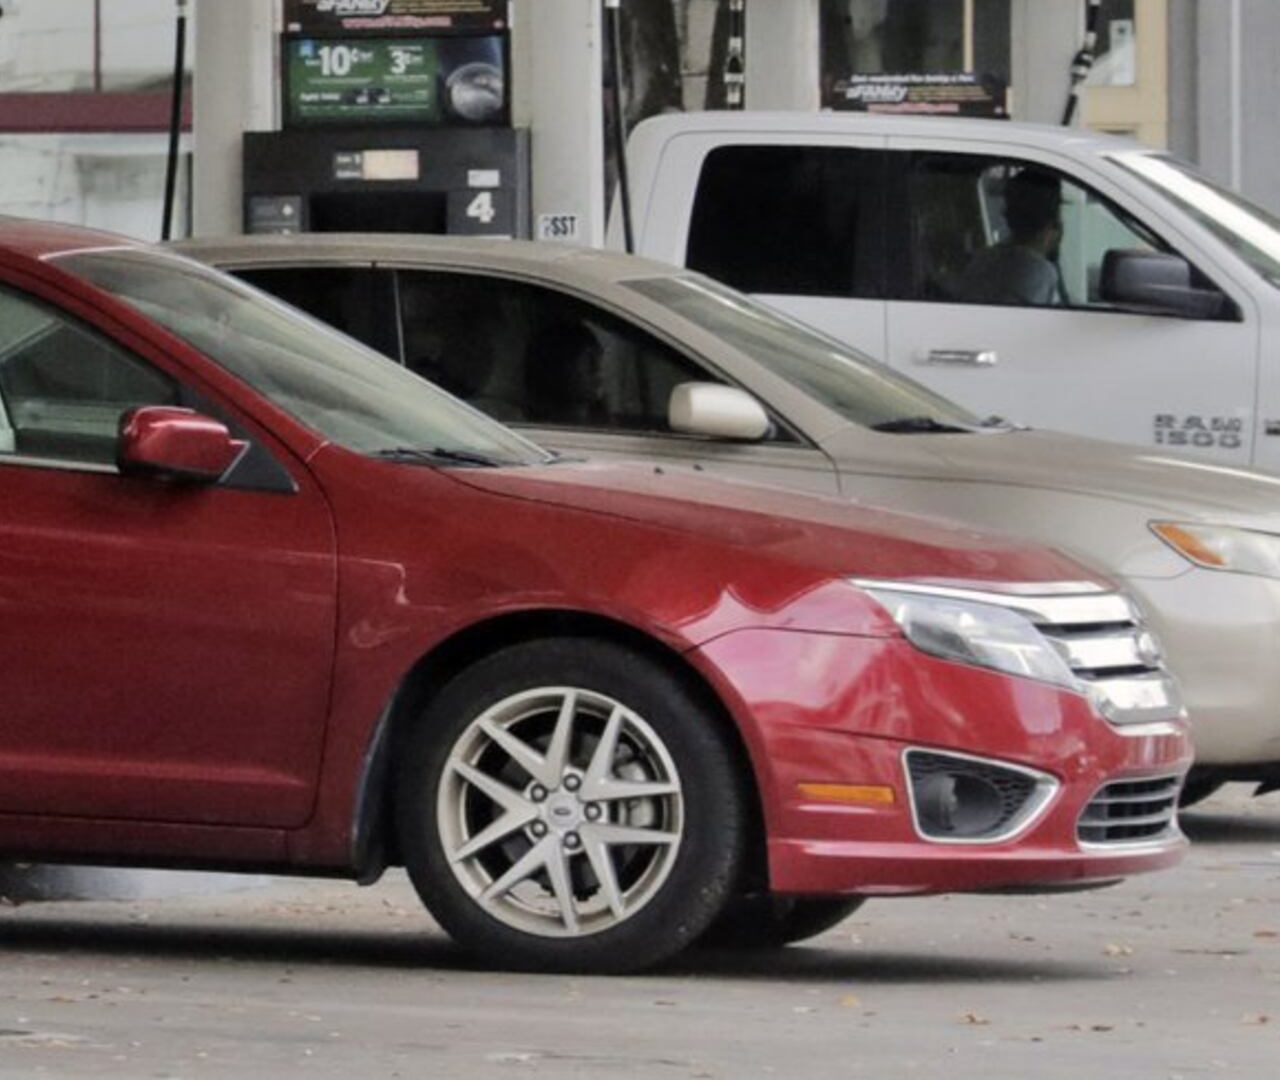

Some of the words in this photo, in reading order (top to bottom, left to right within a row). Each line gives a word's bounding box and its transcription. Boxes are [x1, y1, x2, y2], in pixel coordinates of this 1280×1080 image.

[466, 191, 496, 223] 4
[1154, 414, 1242, 431] RAM
[1154, 430, 1242, 448] 1500
